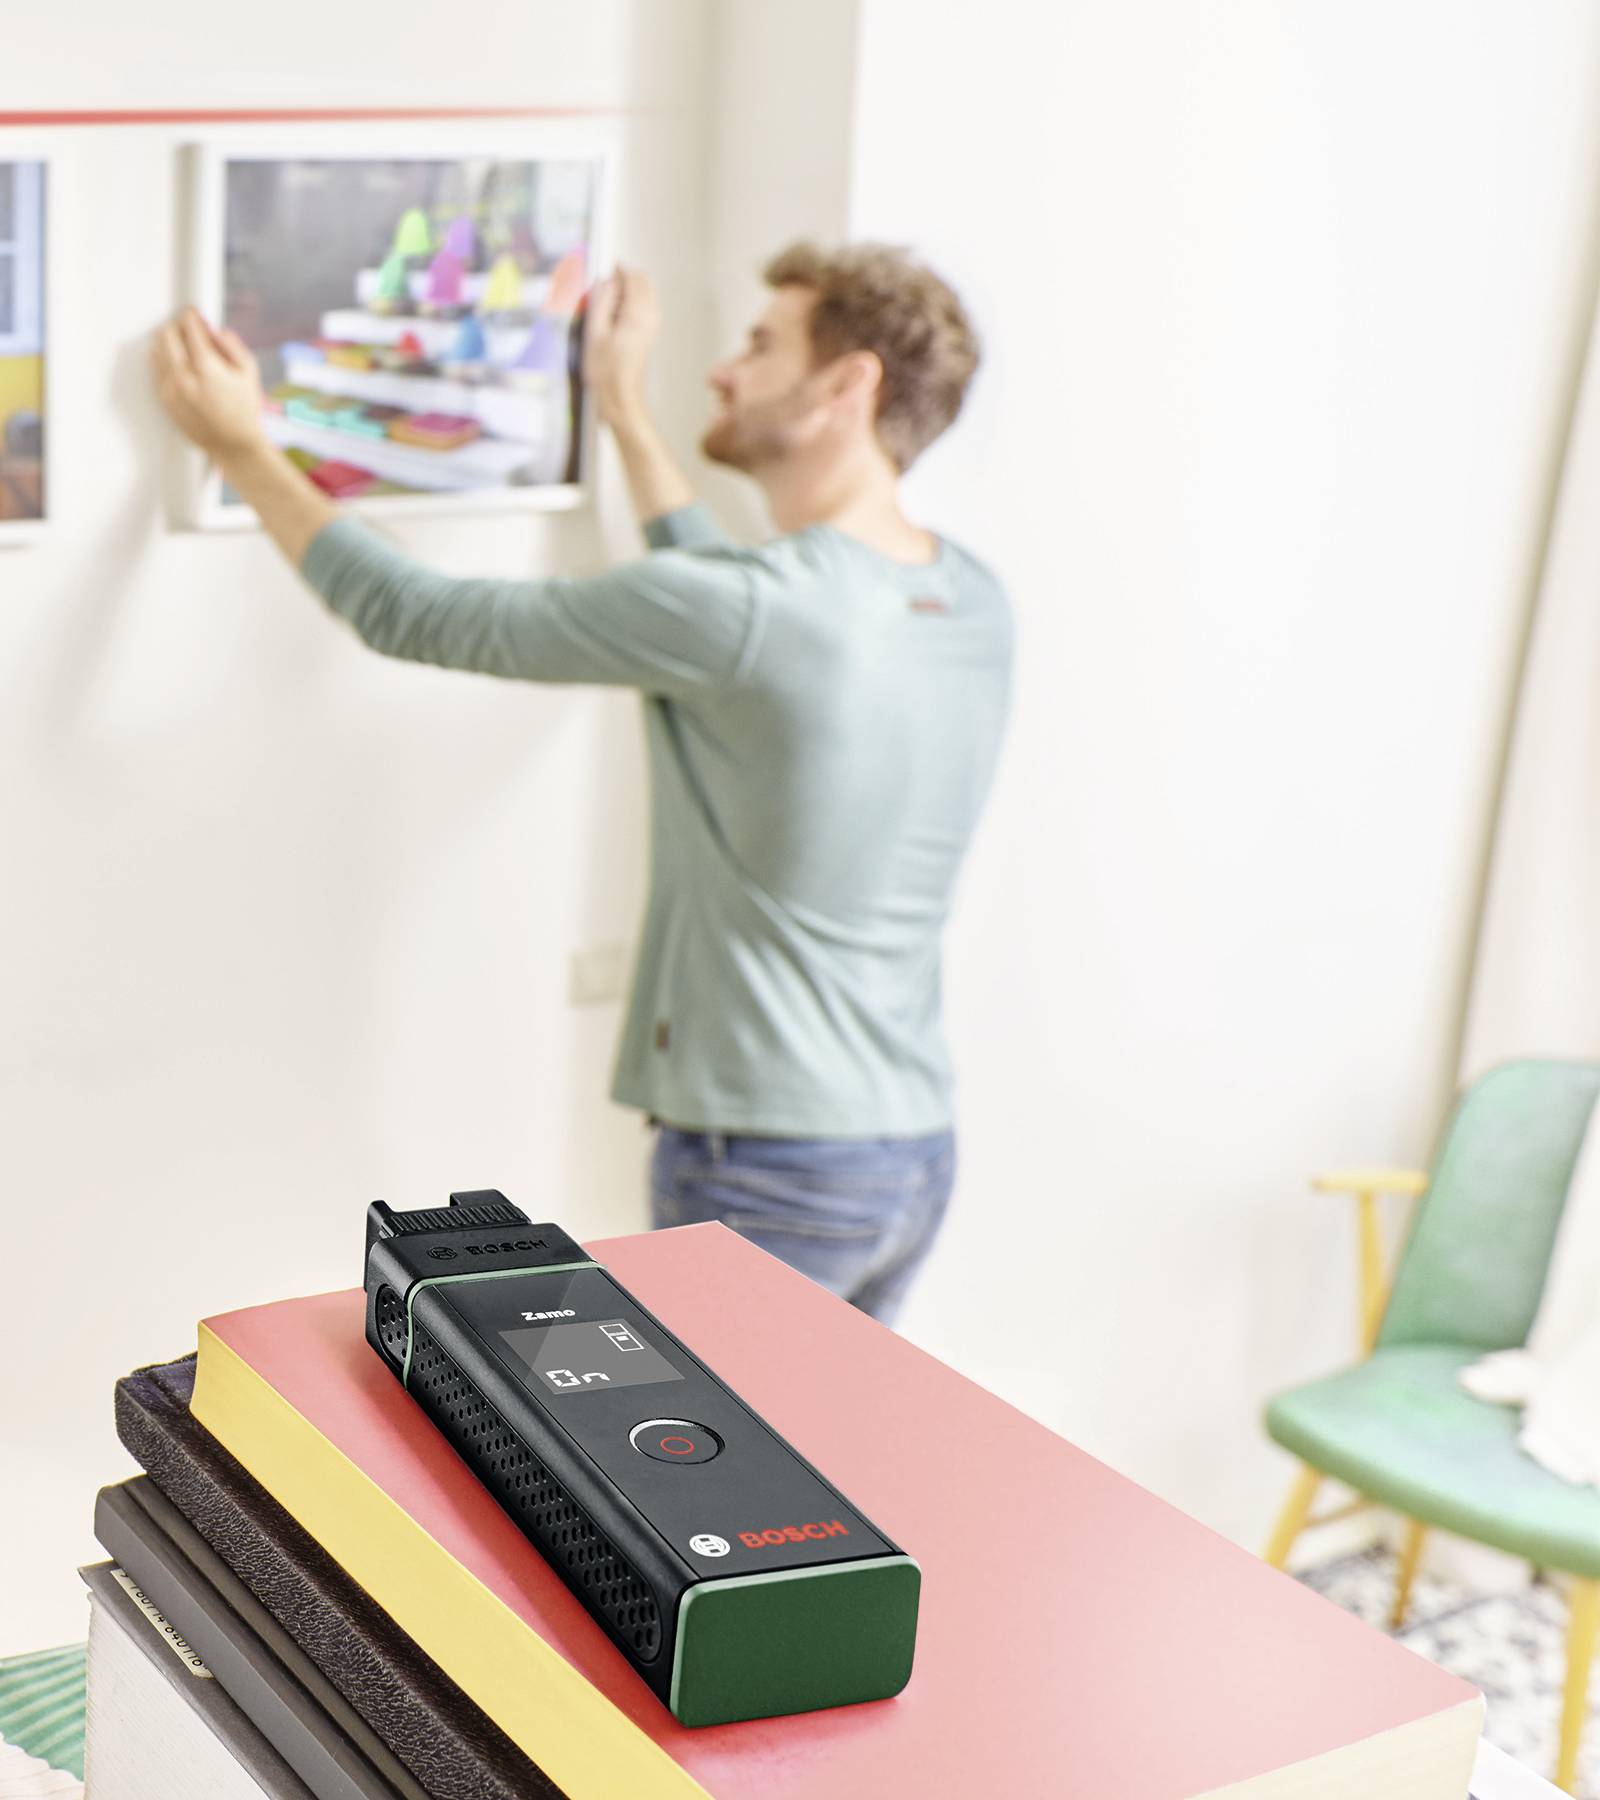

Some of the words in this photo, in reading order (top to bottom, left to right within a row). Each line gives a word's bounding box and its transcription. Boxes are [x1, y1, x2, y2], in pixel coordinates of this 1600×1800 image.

[464, 1239, 550, 1256] BOSCH
[520, 1309, 576, 1321] Zamo
[736, 1519, 850, 1549] BOSCH
